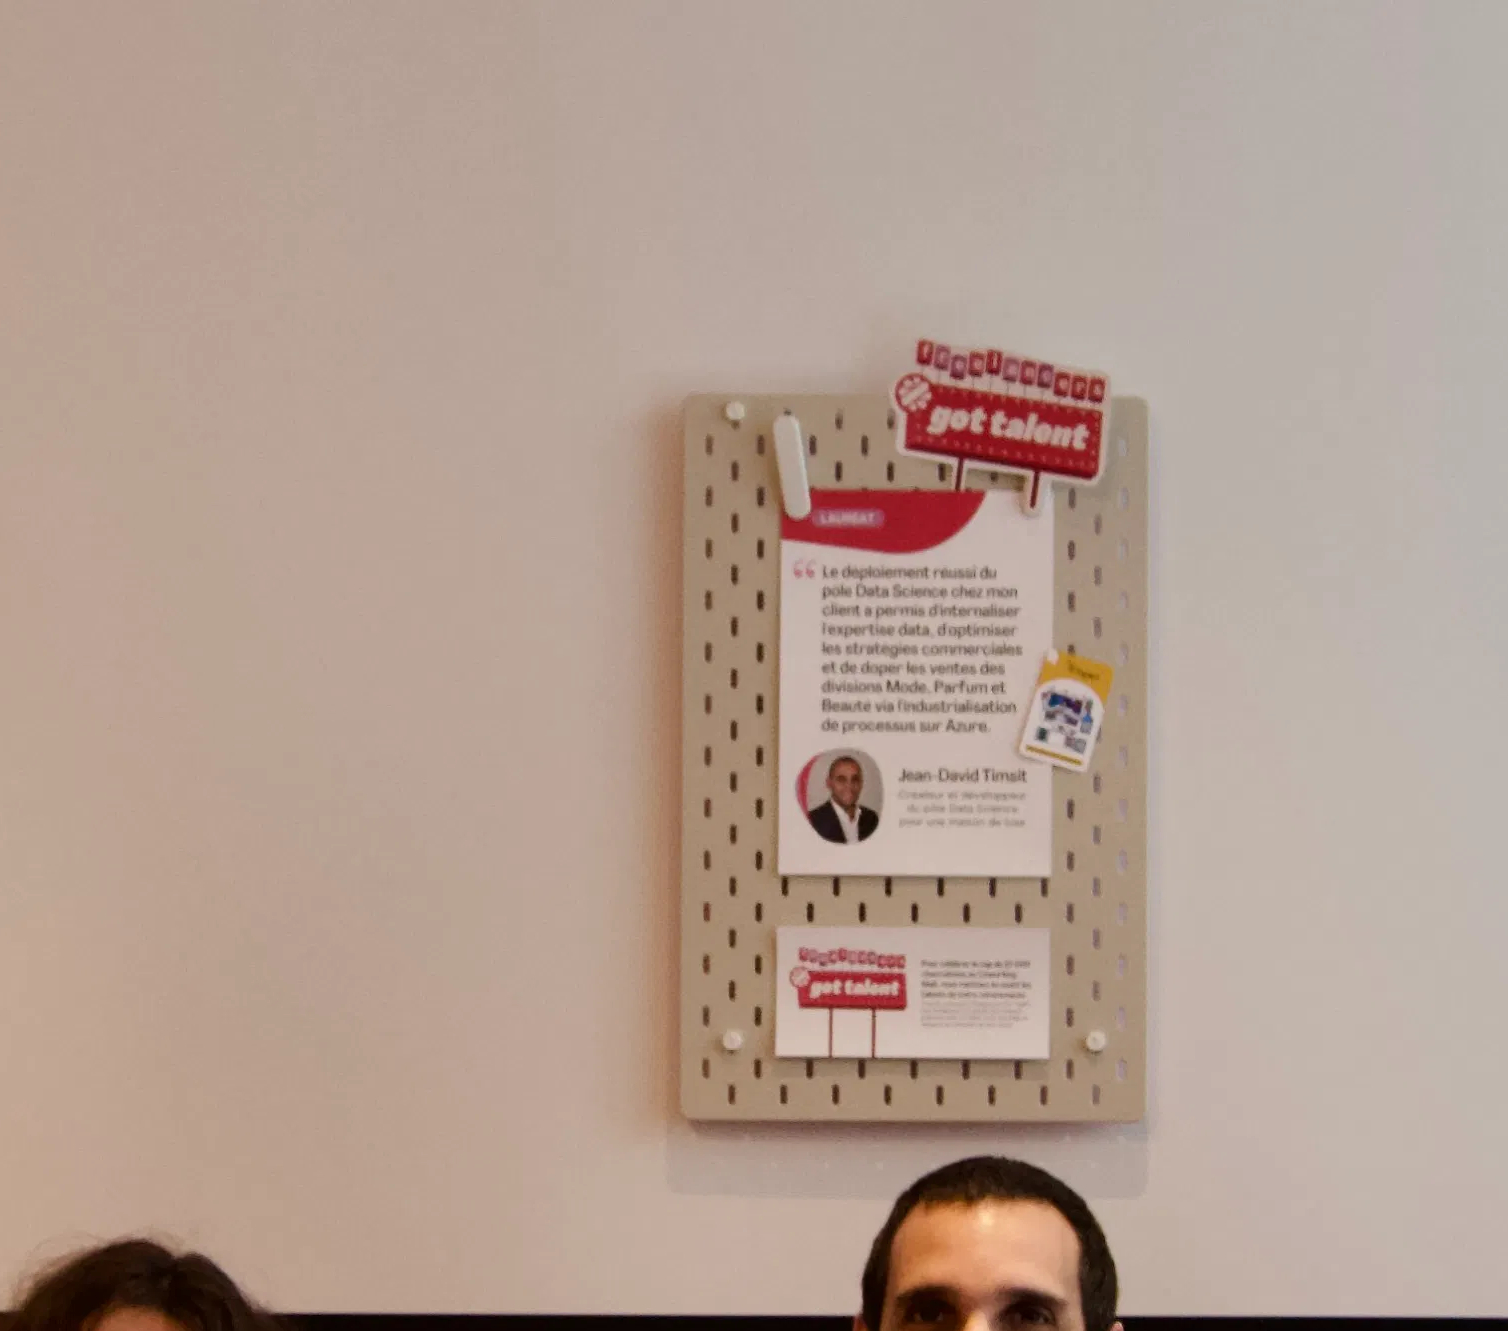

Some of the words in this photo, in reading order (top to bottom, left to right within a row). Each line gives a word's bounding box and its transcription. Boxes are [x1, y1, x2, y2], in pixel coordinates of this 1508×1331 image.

[927, 405, 987, 434] got
[991, 410, 1089, 450] talent
[822, 565, 838, 580] Le
[979, 565, 998, 580] du
[856, 585, 889, 599] Data
[892, 584, 948, 599] Science
[951, 584, 983, 599] chez
[986, 588, 1018, 599] mon
[822, 602, 861, 617] client
[864, 606, 873, 617] a
[875, 604, 925, 621] permis
[928, 602, 1021, 618] d'internaliser
[822, 622, 893, 639] l'expertise
[937, 622, 1018, 639] d'optimiser
[821, 641, 842, 656] les
[921, 641, 1023, 656] commerciales
[821, 661, 837, 675] et
[840, 660, 858, 675] de
[860, 660, 903, 677] doper
[906, 661, 926, 675] les
[929, 662, 977, 675] ventes
[979, 661, 1005, 675] des
[821, 679, 883, 694] divisions
[934, 679, 988, 694] Parfum
[990, 681, 1006, 694] et
[874, 700, 895, 713] via
[897, 698, 1017, 714] l'industrialisation
[821, 718, 839, 732] de
[842, 720, 916, 735] processus
[920, 721, 943, 733] sur
[898, 768, 979, 784] Jean-David
[982, 768, 1028, 783] Timsit
[810, 980, 841, 999] got
[844, 977, 899, 996] talent
